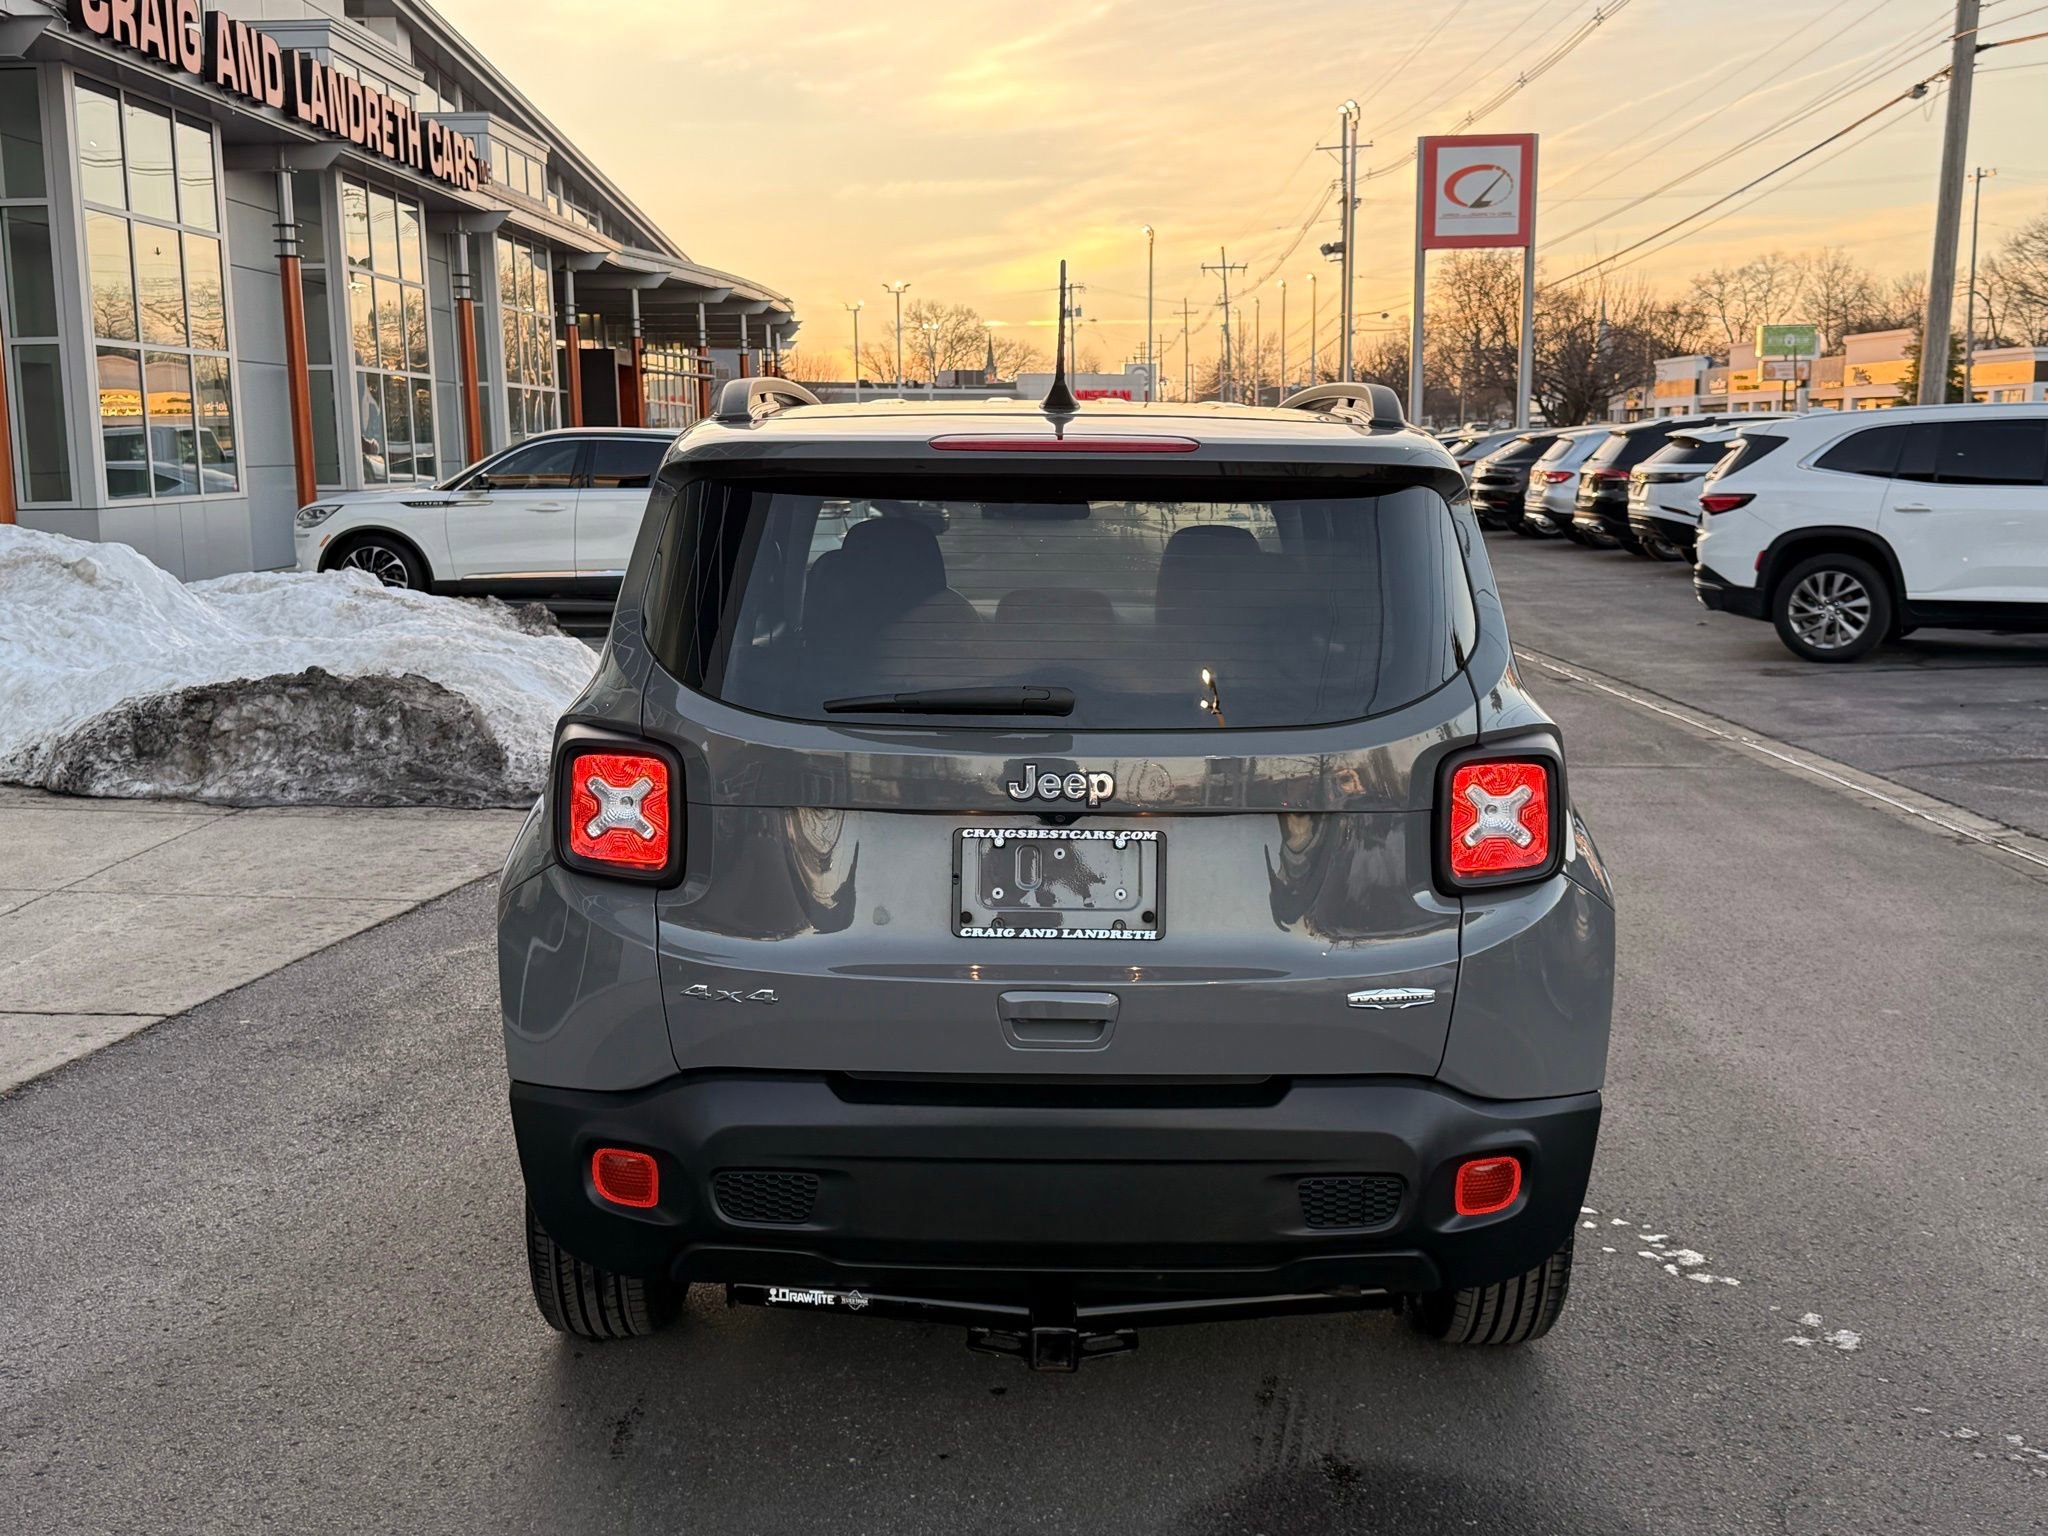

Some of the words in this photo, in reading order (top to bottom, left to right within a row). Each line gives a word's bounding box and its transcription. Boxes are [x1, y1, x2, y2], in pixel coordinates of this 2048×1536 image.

[216, 11, 284, 109] AND
[294, 50, 423, 170] LANDRETH
[428, 118, 478, 192] CARS
[1008, 764, 1115, 807] Jeep
[962, 829, 1158, 841] CRAIGSBESTCARS.COM
[960, 927, 1015, 938] CRAIG
[1019, 927, 1057, 939] AND
[1061, 928, 1157, 940] LANDRETH
[680, 984, 779, 1004] 4x4
